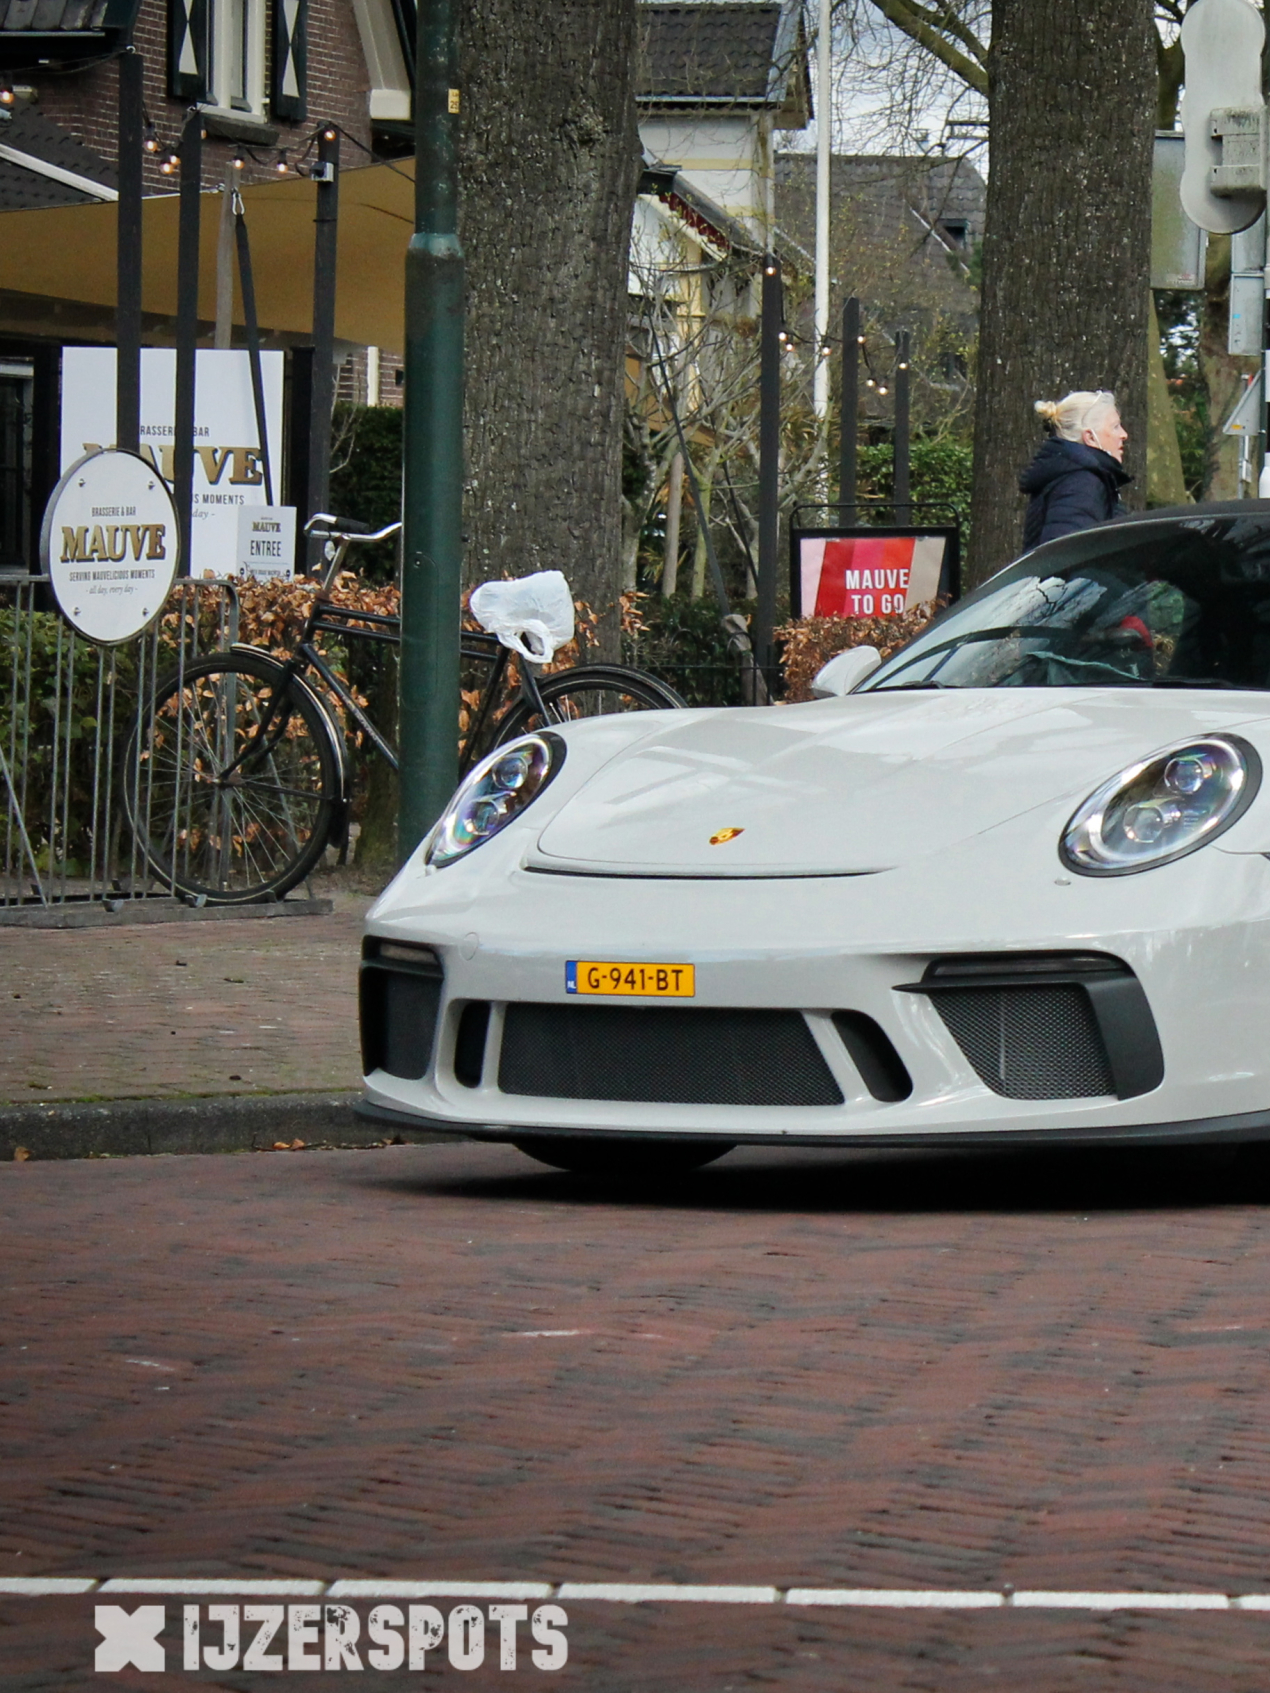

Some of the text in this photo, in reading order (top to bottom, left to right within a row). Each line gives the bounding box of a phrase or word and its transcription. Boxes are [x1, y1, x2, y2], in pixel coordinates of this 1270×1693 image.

[202, 493, 244, 505] MOMENTS
[92, 507, 119, 517] BRASSERIE
[126, 506, 136, 516] BAR
[252, 521, 281, 532] MAUVE
[60, 524, 166, 563] MAUVE
[250, 540, 281, 557] ENTREE
[130, 569, 155, 579] MOMENTS
[845, 569, 909, 590] MAUVE
[852, 594, 904, 614] TO GO
[587, 967, 683, 991] G-941-BT
